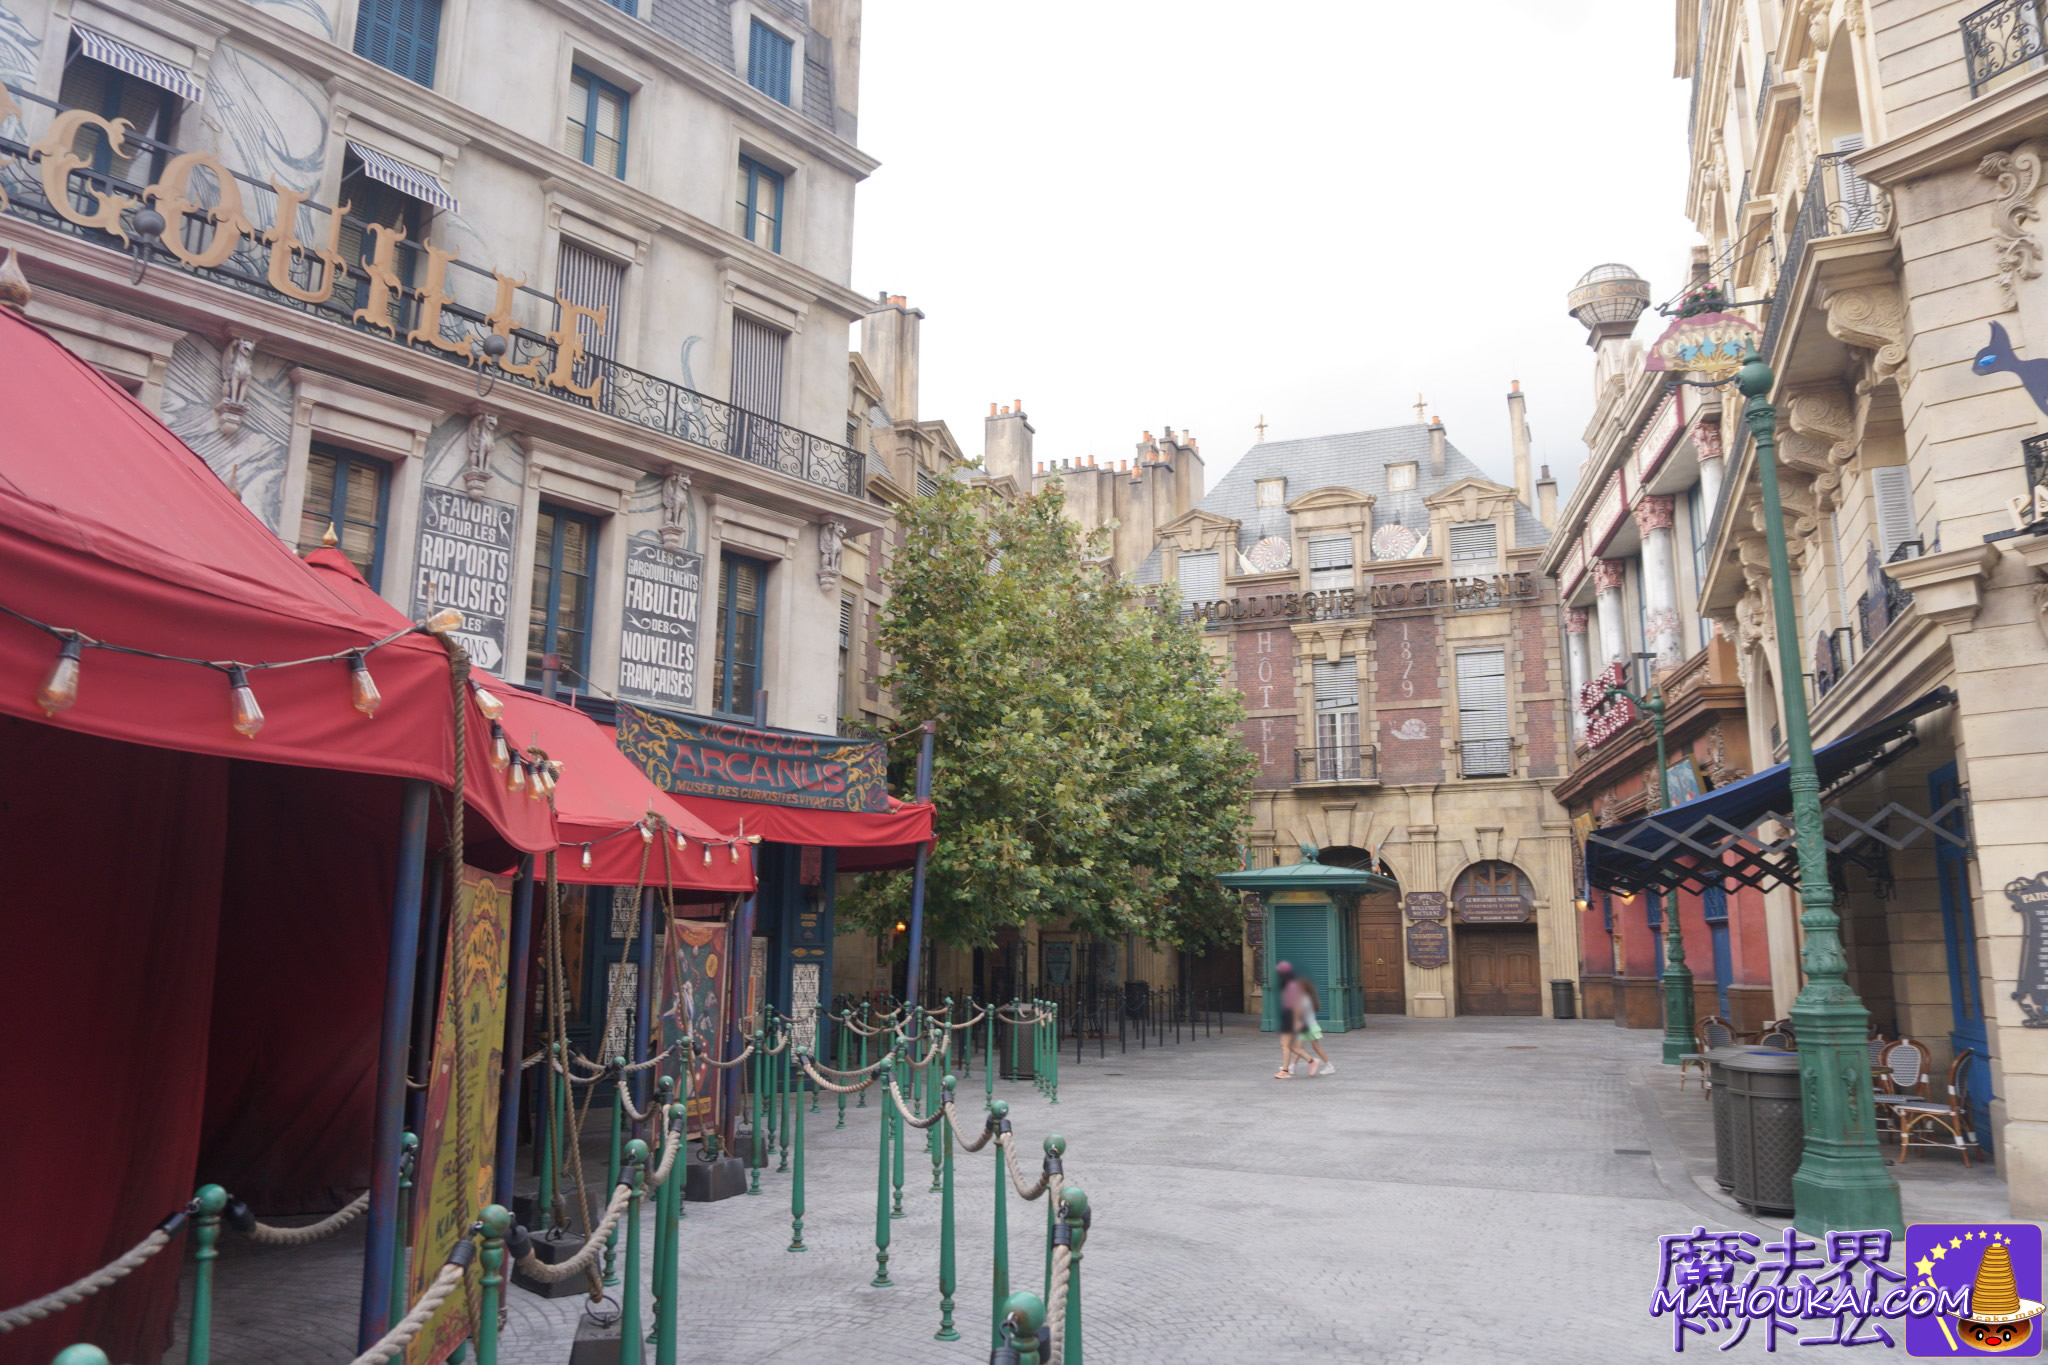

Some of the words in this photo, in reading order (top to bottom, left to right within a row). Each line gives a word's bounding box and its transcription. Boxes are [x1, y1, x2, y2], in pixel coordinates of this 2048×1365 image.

[0, 80, 609, 412] GOUILLE
[439, 515, 472, 538] POUR
[474, 523, 496, 543] LES
[440, 493, 498, 528] FAVORI
[420, 533, 508, 583] RAPPORTS
[627, 558, 698, 590] GARGOUILLEMENTS
[656, 551, 674, 566] LES
[417, 567, 505, 616] EXCLUSIFS
[624, 576, 697, 623] FABULEUX
[1193, 588, 1357, 622] MOLLUSQUE
[1371, 572, 1531, 608] NOCTURNE
[461, 616, 482, 633] LES
[651, 618, 670, 634] DES
[621, 630, 695, 671] NOUVELLES
[1401, 622, 1414, 698] 1879
[620, 661, 693, 698] FRANÇAISES
[1256, 631, 1275, 765] HÔTEL
[717, 724, 813, 757] CIRQUE
[671, 743, 847, 794] ARCANUS
[675, 779, 715, 795] MUSÉE
[716, 784, 739, 798] DES
[799, 794, 846, 809] VIVANTES
